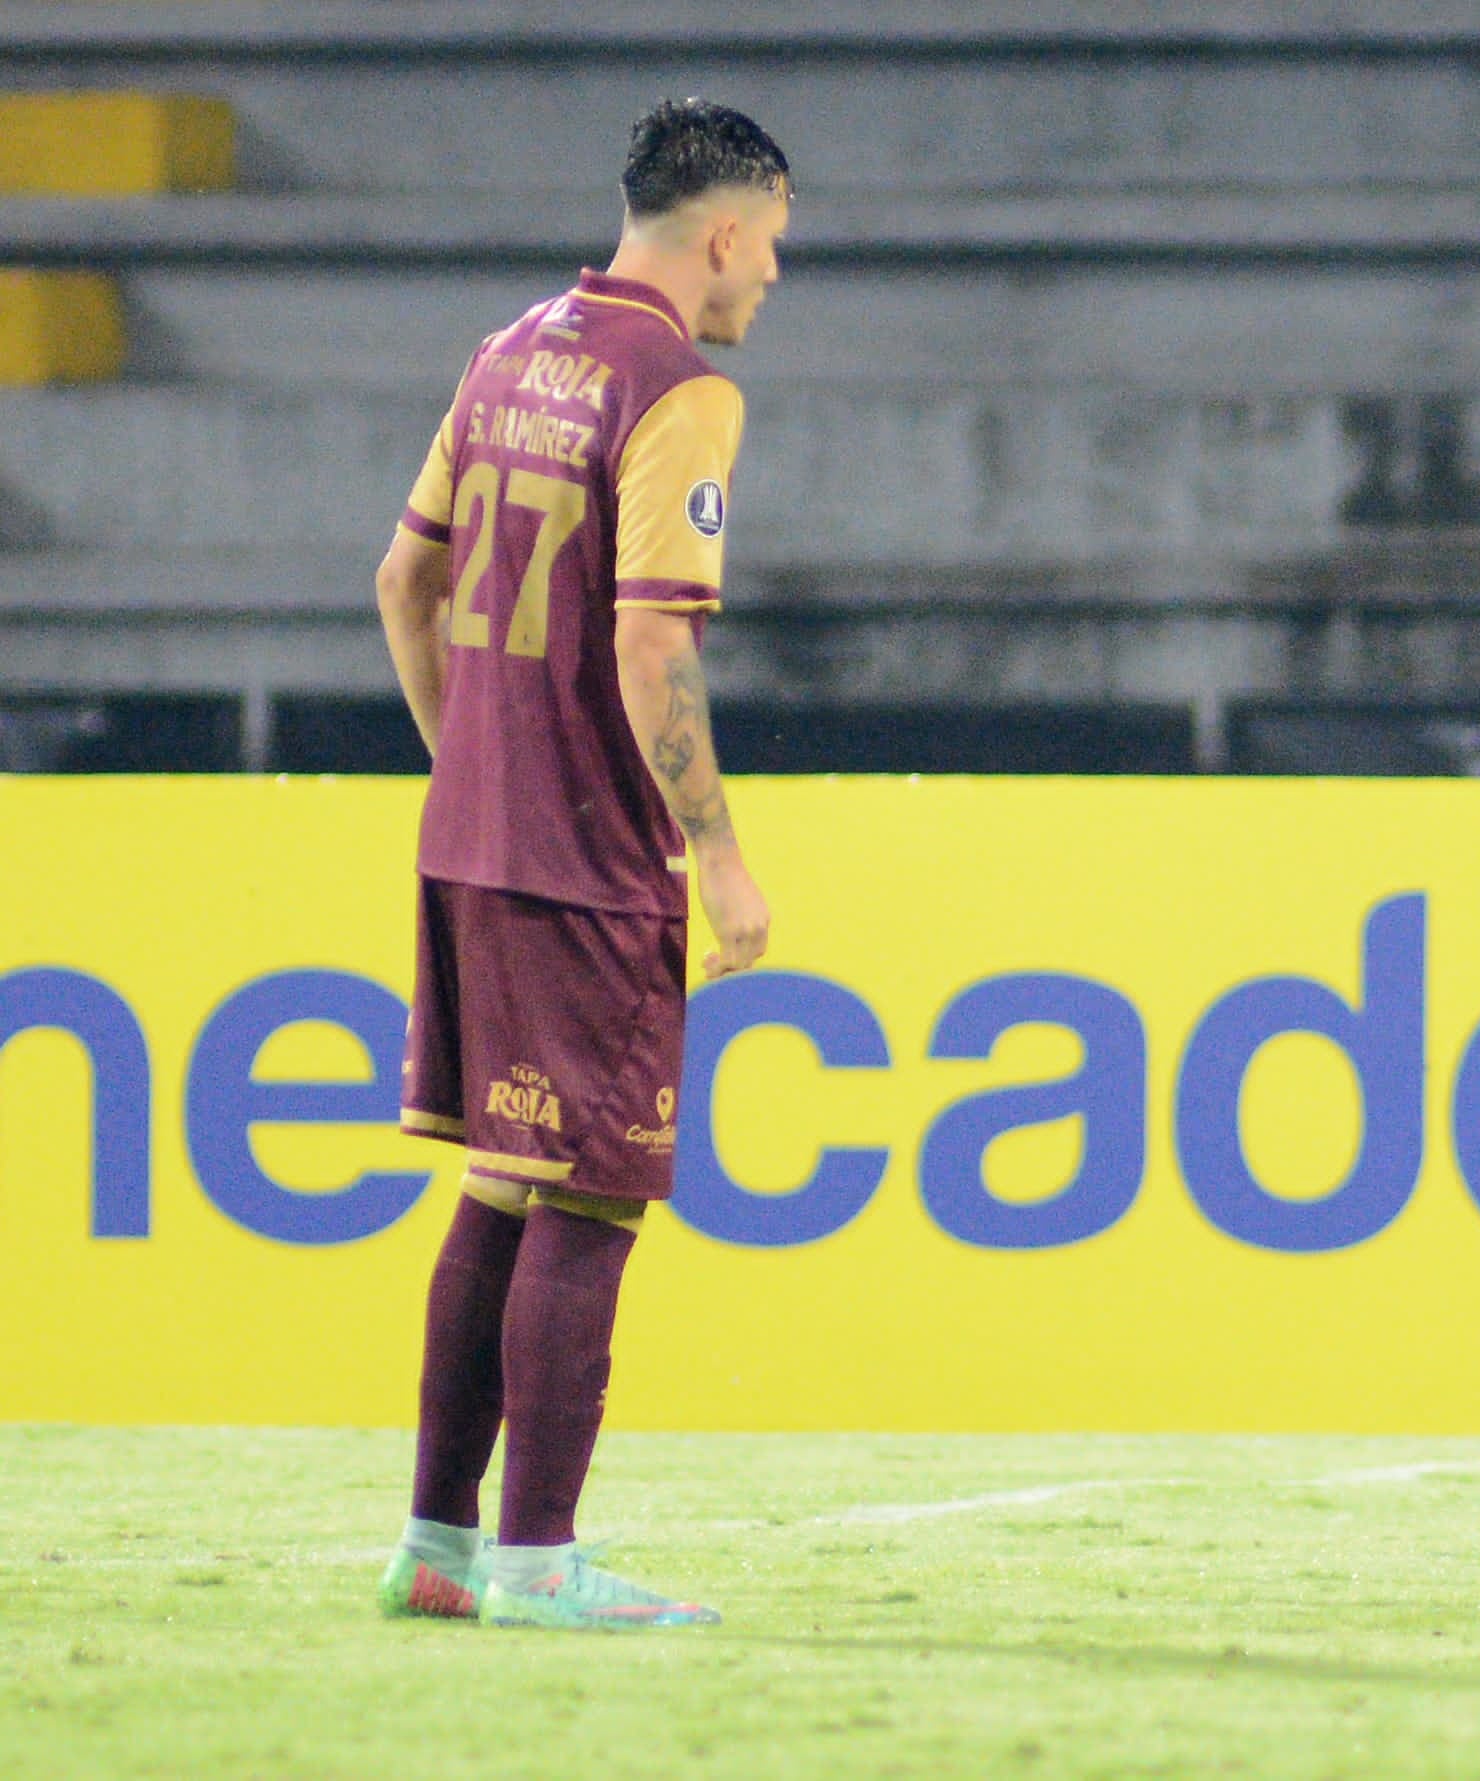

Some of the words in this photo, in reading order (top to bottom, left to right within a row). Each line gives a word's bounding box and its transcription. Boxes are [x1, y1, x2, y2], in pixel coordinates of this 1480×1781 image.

[517, 350, 615, 411] ROJA
[467, 402, 486, 443] S.
[489, 405, 595, 467] RAMÍREZ
[450, 462, 586, 660] 27
[484, 1082, 562, 1132] ROJA
[511, 1065, 551, 1090] TAPA
